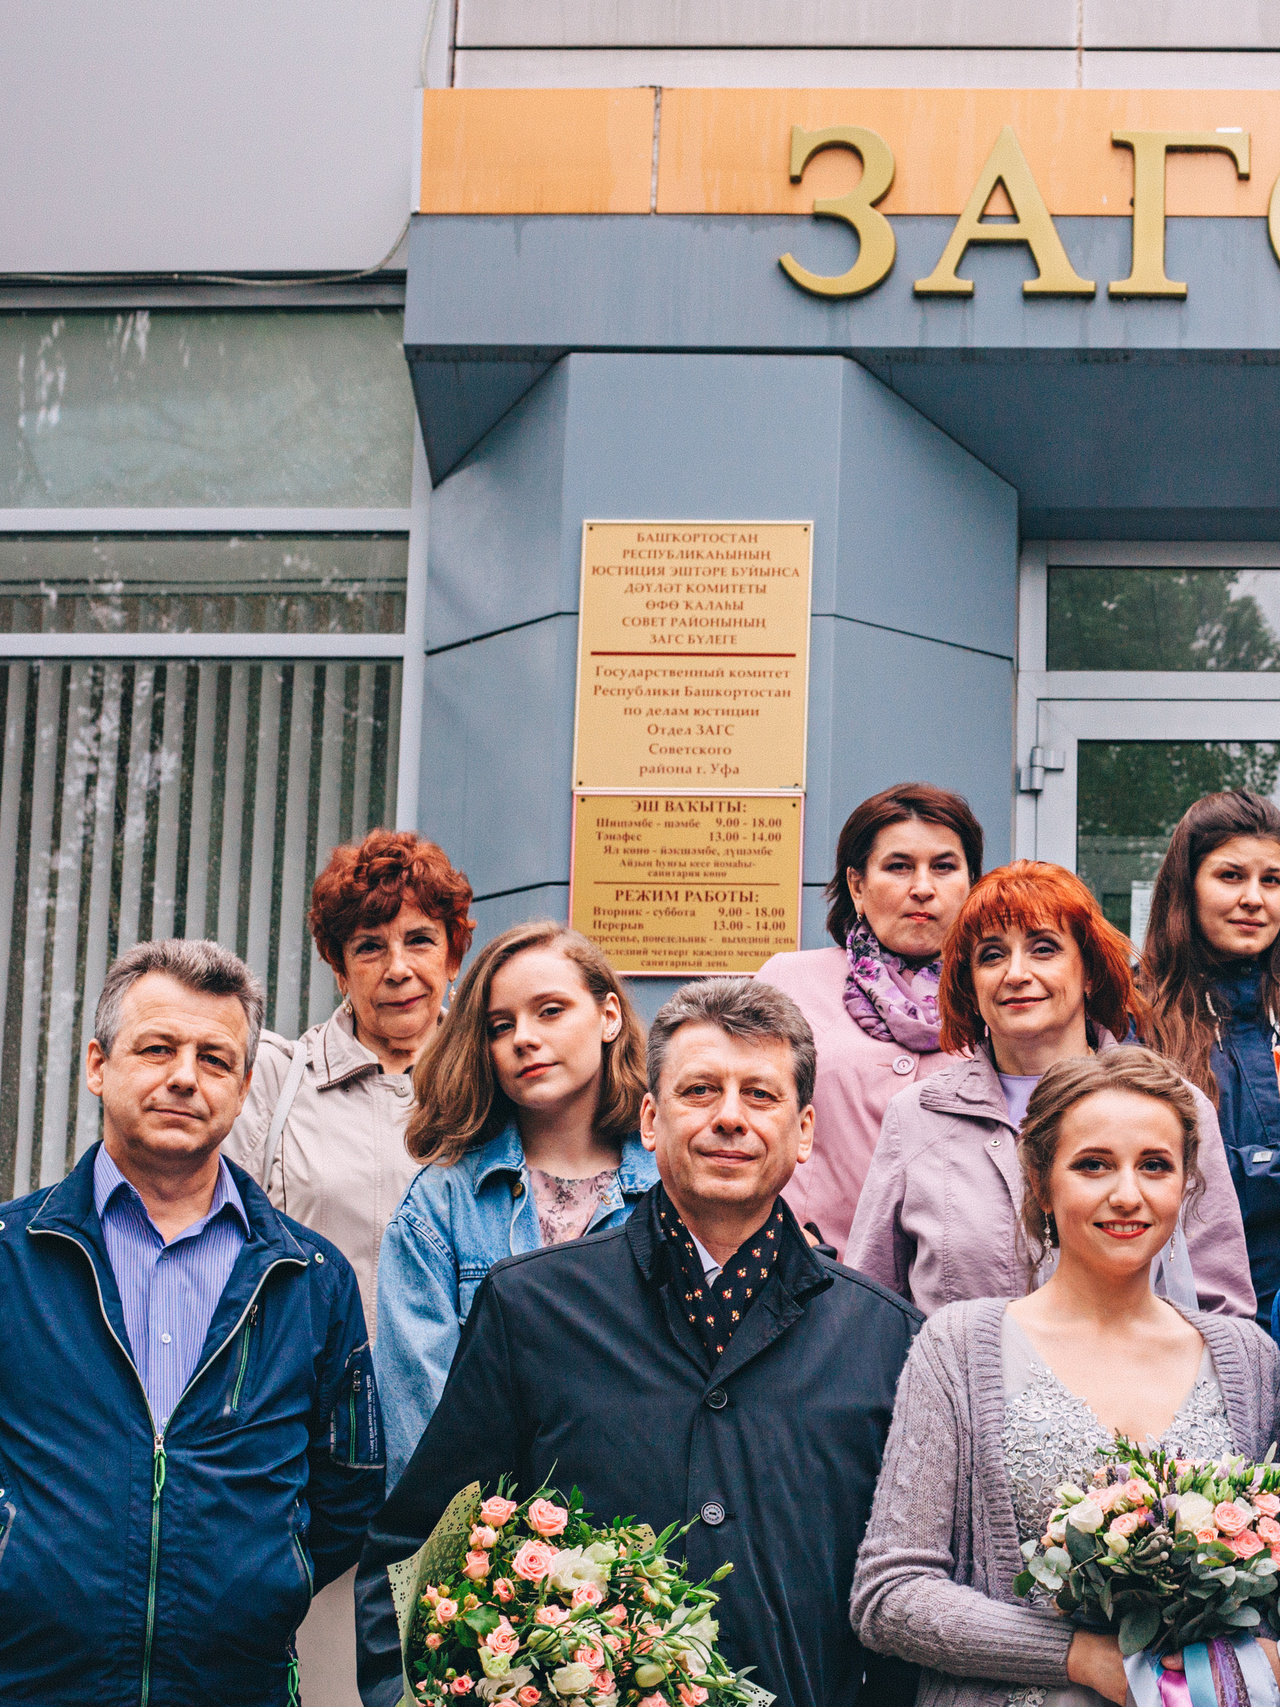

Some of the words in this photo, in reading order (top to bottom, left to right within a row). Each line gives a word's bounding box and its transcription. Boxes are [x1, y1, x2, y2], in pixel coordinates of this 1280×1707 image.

[592, 566, 665, 577] ЮСТИЦИЯ
[731, 565, 800, 577] БУЙЫНСА
[686, 583, 767, 594] КОМИТЕТЫ
[622, 616, 666, 627] СОВЕТ
[650, 634, 684, 644] ЗАГС
[595, 665, 724, 680] Государственный
[729, 669, 790, 678] комитет
[593, 685, 680, 700] Республики
[684, 686, 791, 700] Башкортостан
[623, 707, 642, 716] по
[645, 707, 689, 717] делам
[693, 708, 760, 717] юстиции
[647, 723, 692, 736] Отдел
[695, 724, 735, 736] ЗАГС
[648, 743, 732, 755] Советского
[639, 764, 692, 777] района
[696, 766, 706, 774] г.
[710, 763, 740, 778] Уфа
[631, 800, 659, 812] ЭШ
[715, 817, 740, 828] 9.00
[752, 818, 782, 828] 18.00
[709, 831, 740, 842] 13.00
[752, 832, 782, 842] 14.00
[603, 845, 619, 855] Ял
[615, 890, 679, 902] РЕЖИМ
[684, 890, 759, 903] РАБОТЫ:
[593, 906, 643, 918] Вторник
[653, 907, 696, 919] суббота
[718, 907, 742, 917] 9.00
[755, 907, 785, 917] 18.00
[593, 920, 645, 932] Перерыв
[713, 920, 743, 931] 13.00
[756, 921, 786, 931] 14.00
[642, 935, 707, 944] понедельник
[721, 935, 770, 944] выходной
[651, 949, 688, 958] четверг
[692, 949, 734, 957] каждого
[640, 959, 702, 969] санитарный
